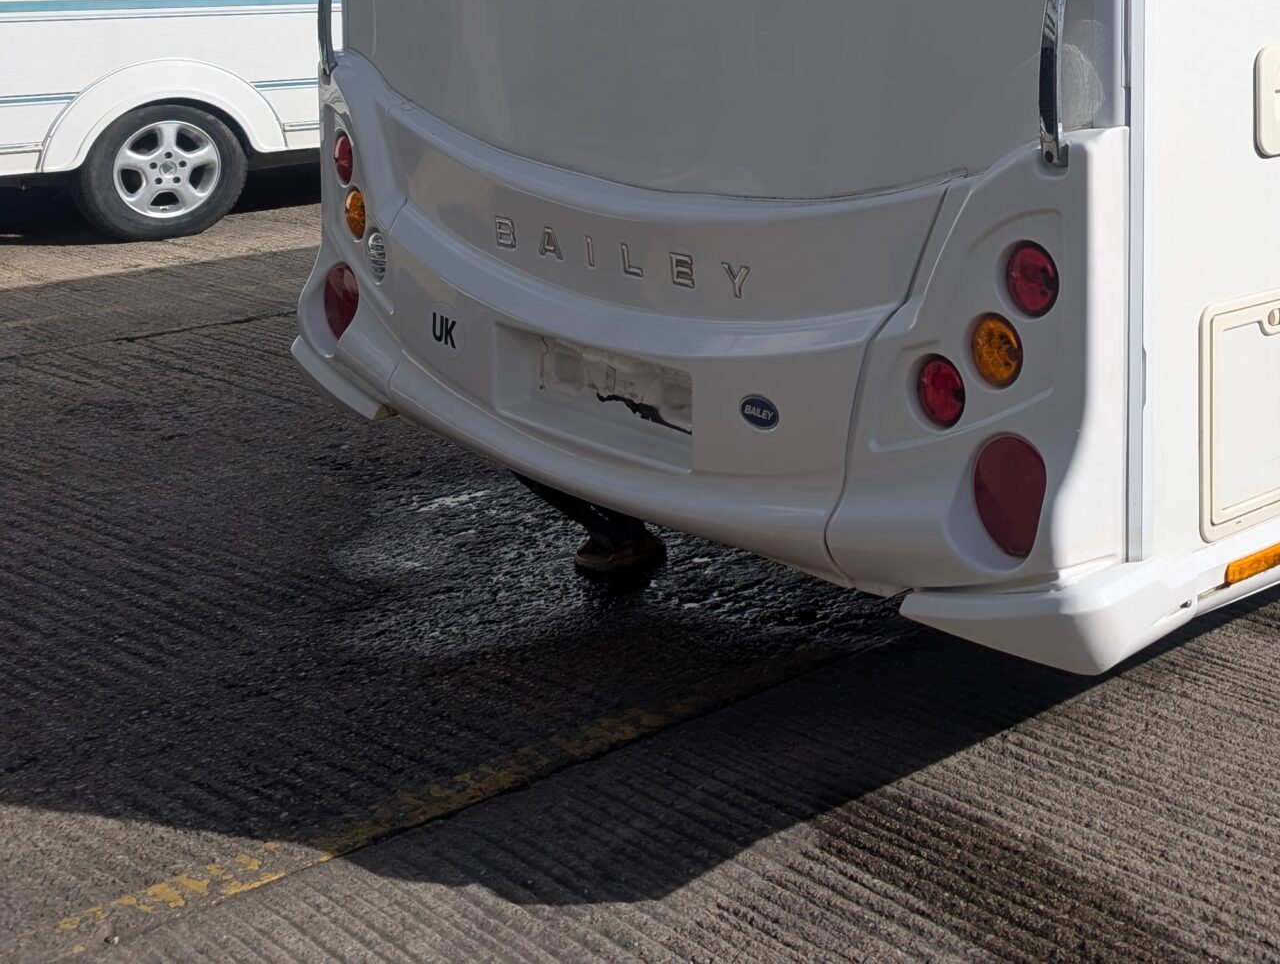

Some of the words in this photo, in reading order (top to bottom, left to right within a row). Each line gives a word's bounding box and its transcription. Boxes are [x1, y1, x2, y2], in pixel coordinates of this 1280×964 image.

[495, 215, 751, 299] BAILEY
[432, 311, 457, 350] UK
[744, 404, 774, 421] BAILEY
